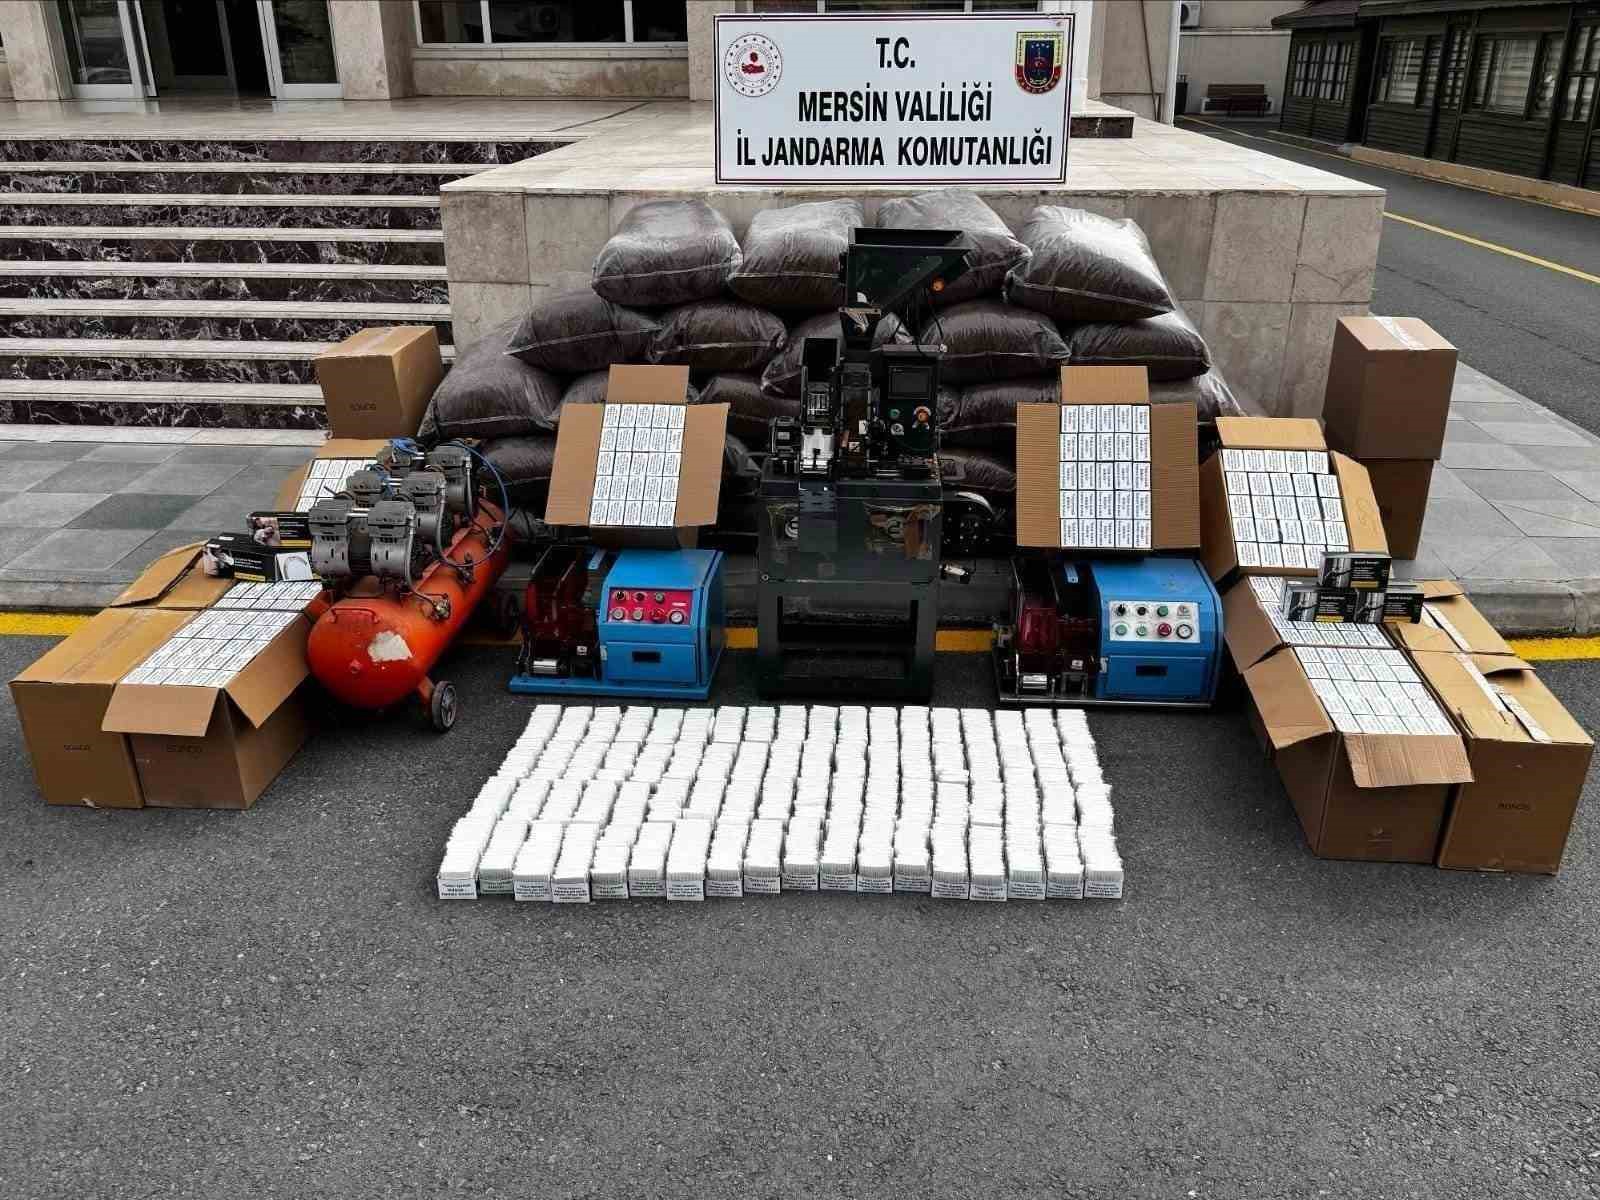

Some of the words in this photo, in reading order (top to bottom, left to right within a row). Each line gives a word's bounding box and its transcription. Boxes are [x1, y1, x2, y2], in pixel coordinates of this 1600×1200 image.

[875, 37, 916, 69] T.C.
[798, 82, 888, 122] MERSİN
[894, 82, 992, 122] VALİLİĞİ
[737, 129, 756, 166] İL
[761, 137, 885, 167] JANDARMA
[897, 128, 1052, 166] KOMUTANLIĞI
